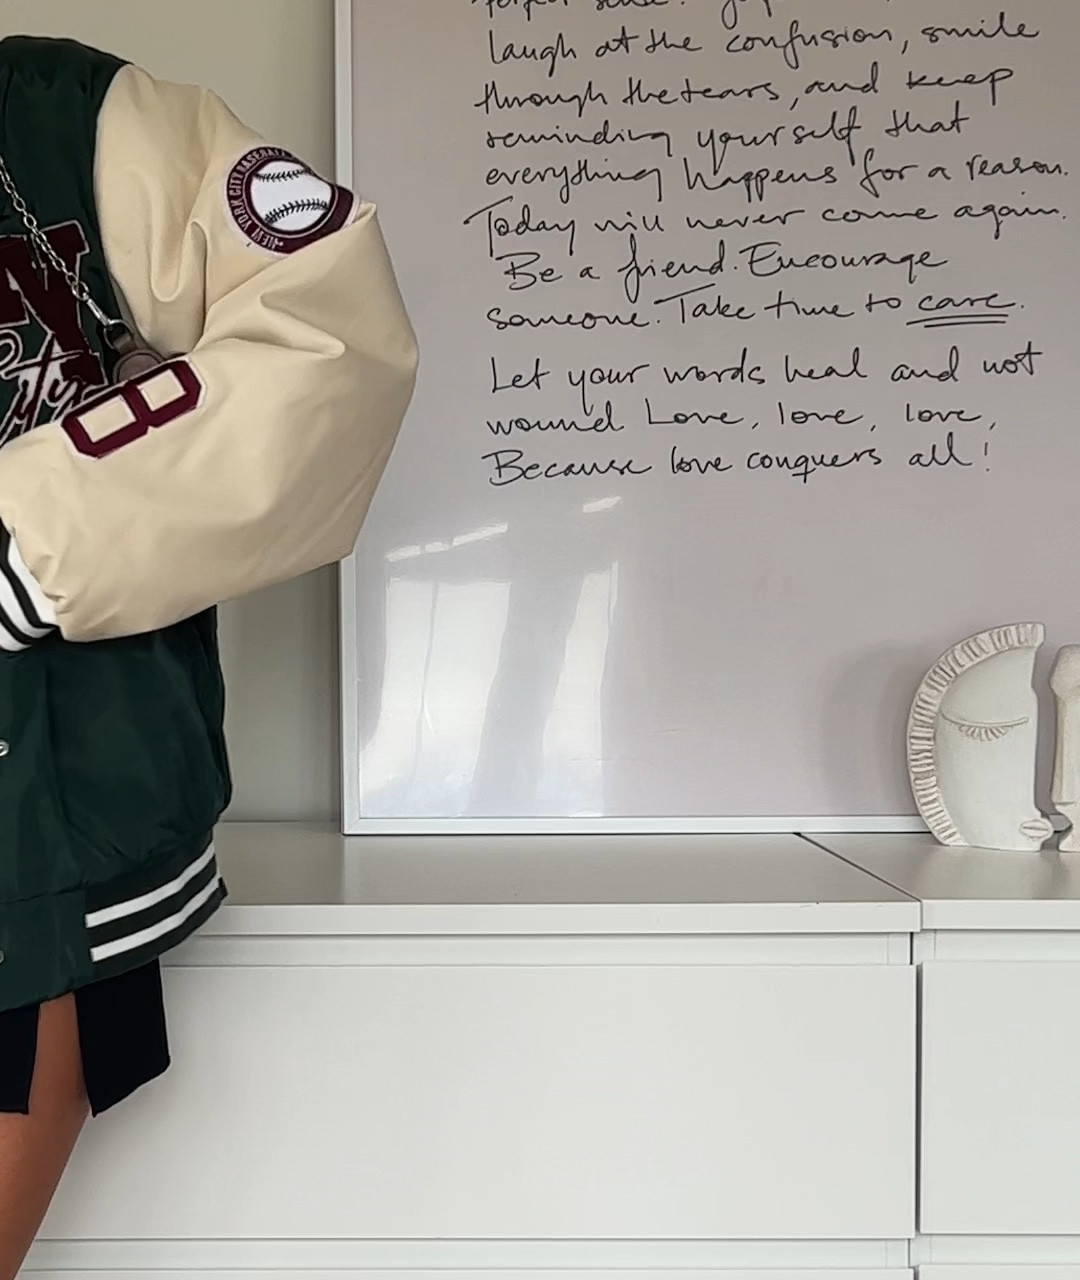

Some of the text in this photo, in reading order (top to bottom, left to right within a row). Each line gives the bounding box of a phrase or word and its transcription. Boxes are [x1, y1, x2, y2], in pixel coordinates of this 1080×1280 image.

[489, 12, 1040, 77] laugh at the confusion, smile
[474, 81, 608, 118] through
[804, 61, 879, 95] and
[906, 68, 1014, 107] keep
[486, 120, 673, 157] reminding
[885, 100, 970, 137] that
[228, 172, 243, 197] CITY
[486, 148, 1069, 204] everything happens for a reason.
[230, 199, 252, 231] YORK
[463, 193, 1067, 257] Today will never come again.
[495, 252, 563, 291] Be
[579, 265, 601, 280] a
[738, 241, 949, 284] Encourage
[486, 283, 1025, 331] someone. Take time to care.
[490, 341, 1044, 416] Let your words heal and not
[645, 397, 759, 430] Love,
[777, 401, 877, 433] love,
[905, 403, 997, 431] love,
[481, 449, 653, 486] Because
[671, 445, 734, 474] love
[746, 448, 883, 485] conquers
